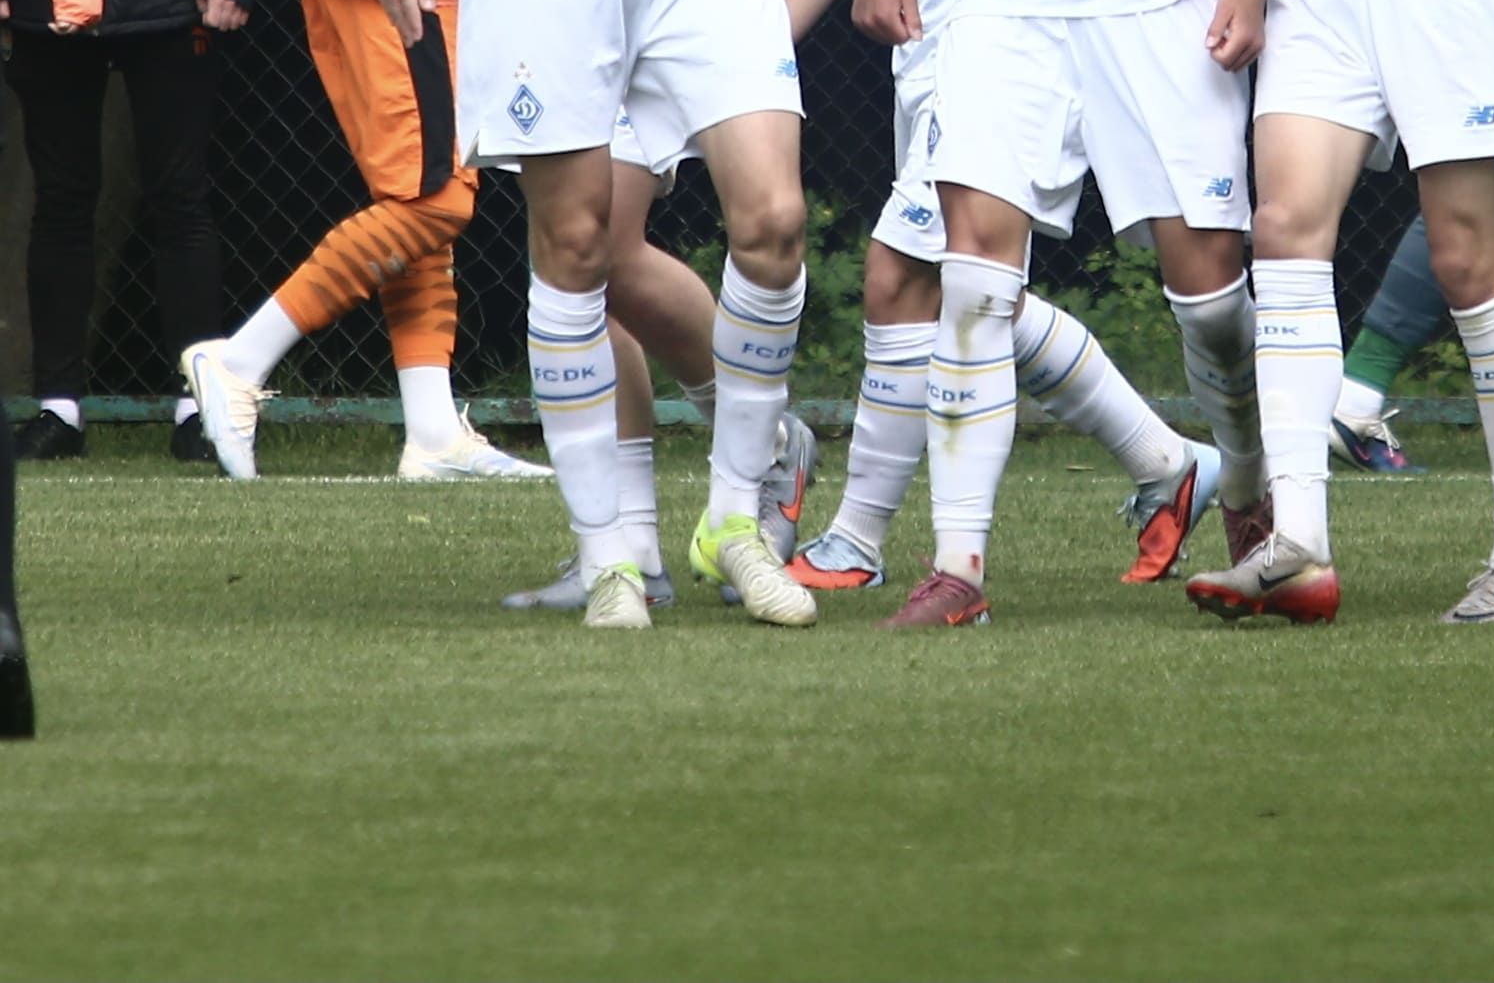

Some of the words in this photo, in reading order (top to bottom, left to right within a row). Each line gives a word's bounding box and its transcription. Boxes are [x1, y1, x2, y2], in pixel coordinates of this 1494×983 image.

[741, 342, 799, 360] FCD
[533, 365, 597, 383] FCDK
[863, 379, 898, 394] DK
[926, 380, 977, 403] CDK
